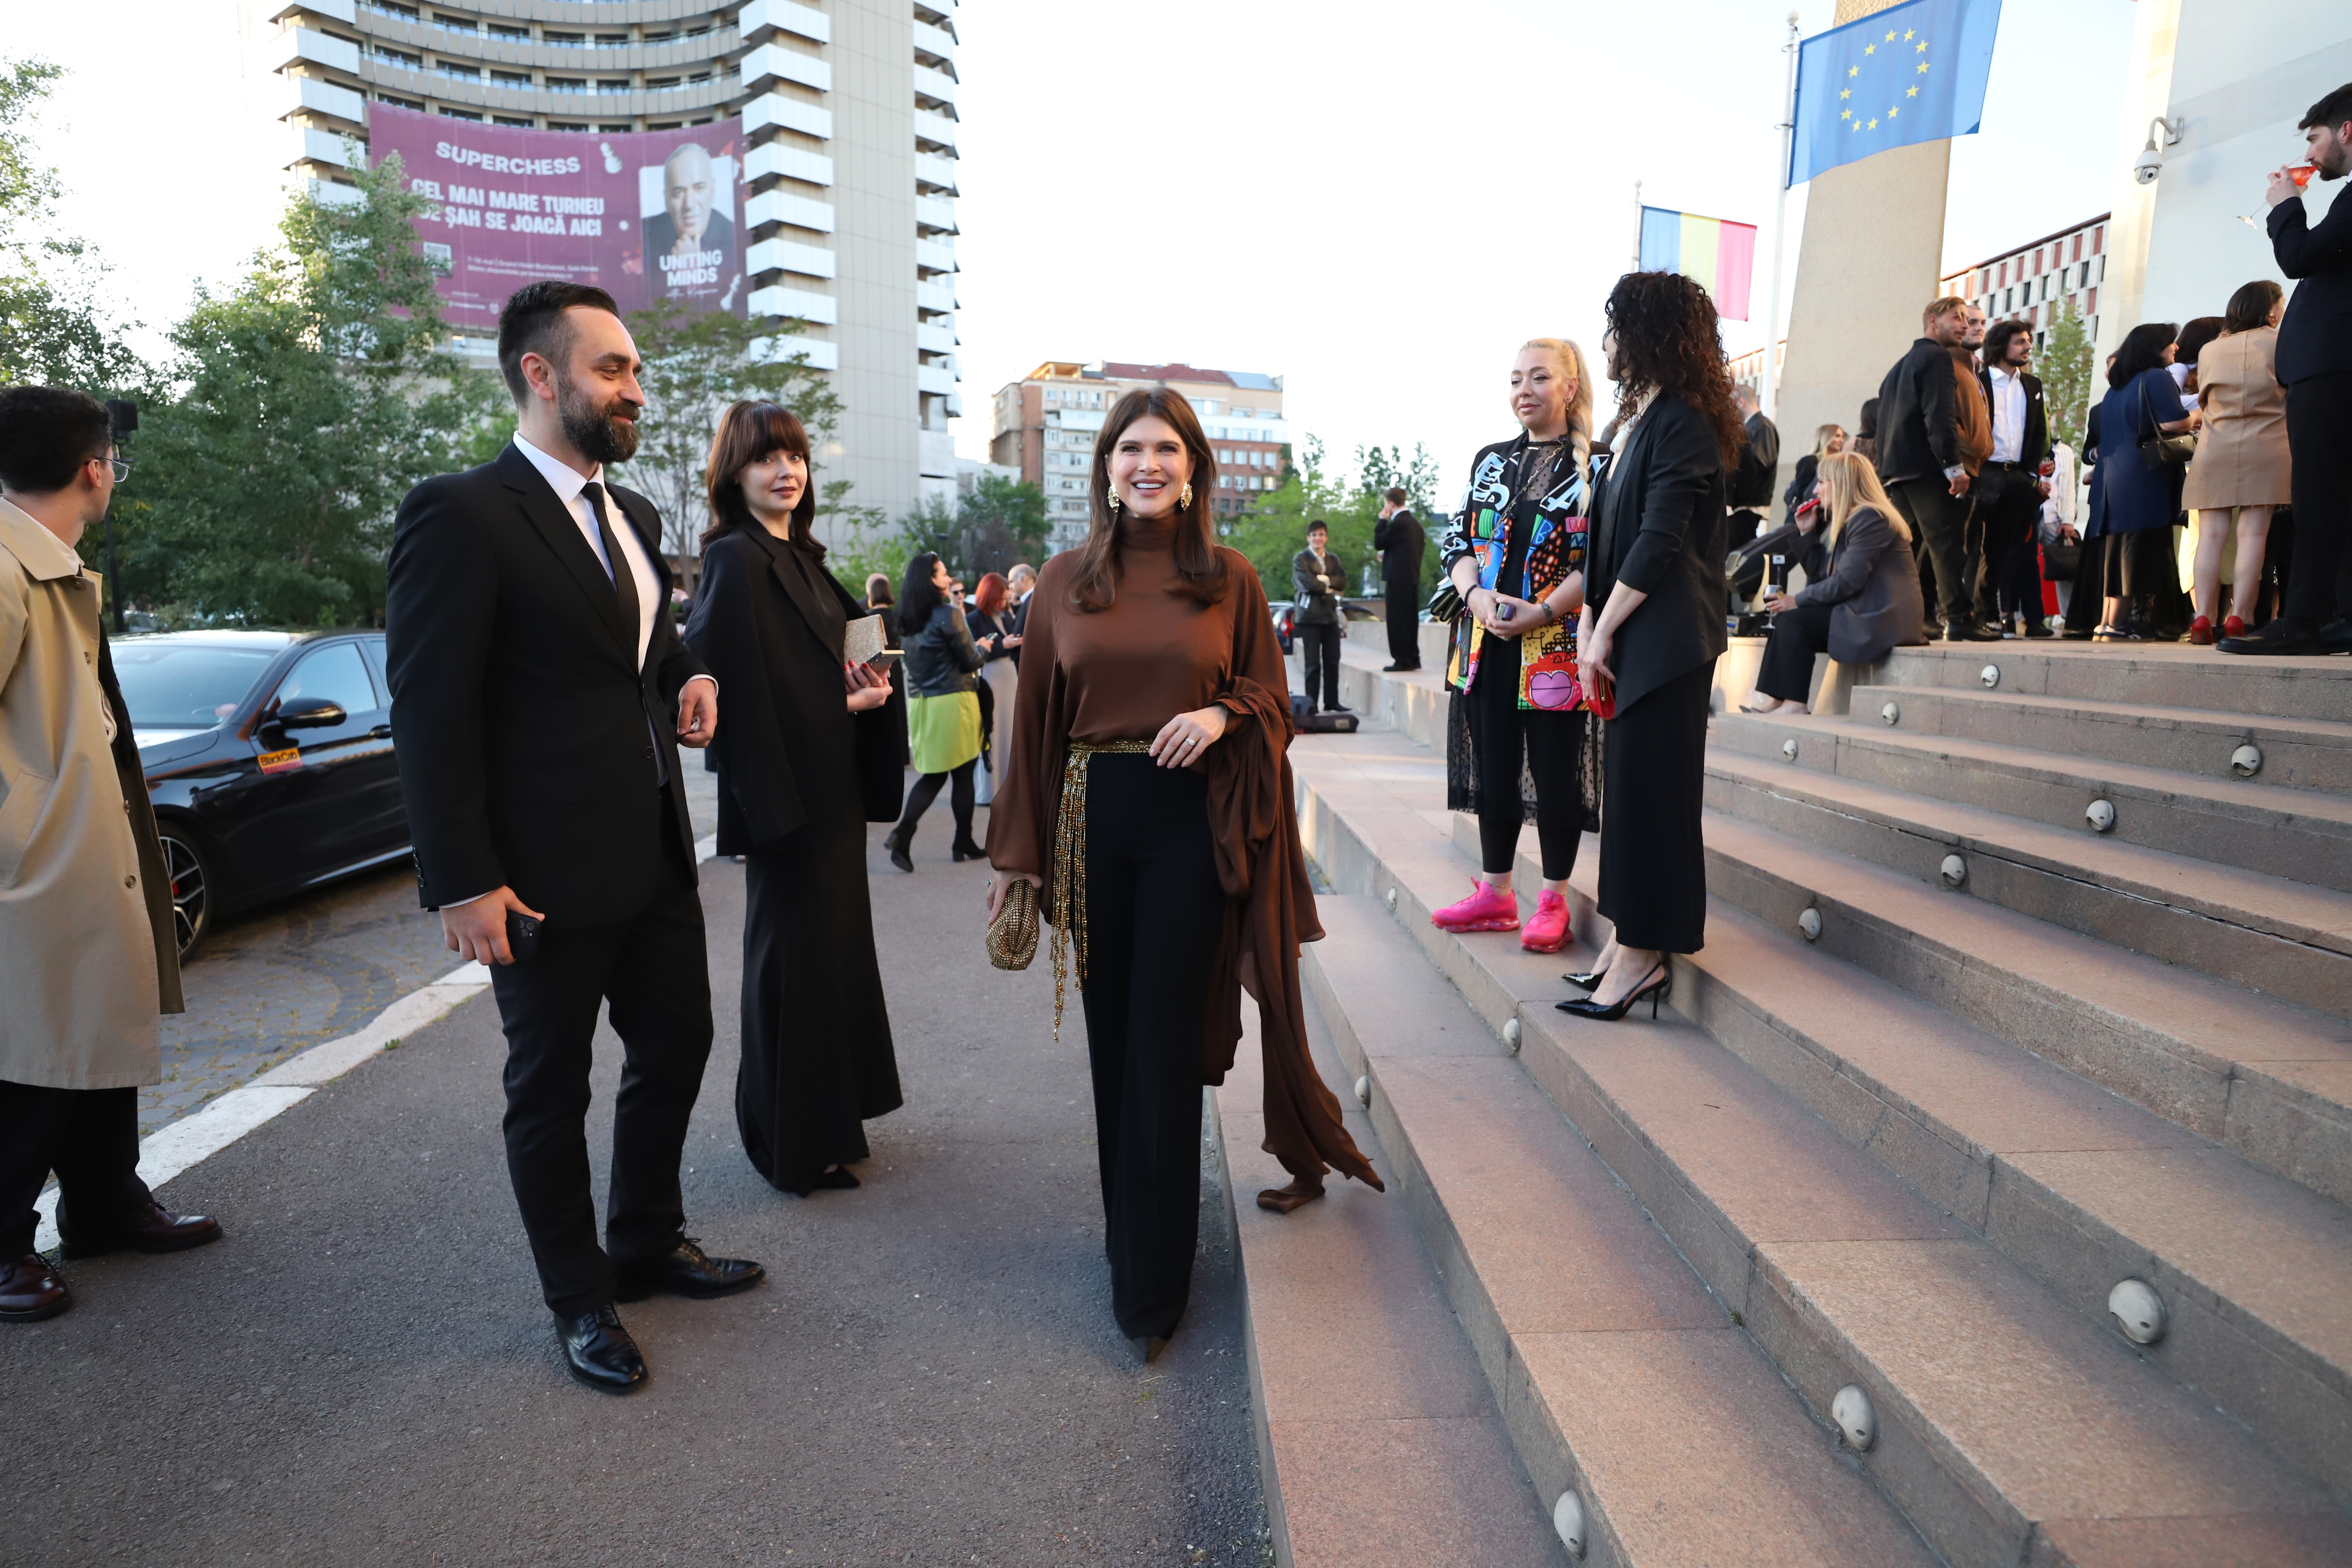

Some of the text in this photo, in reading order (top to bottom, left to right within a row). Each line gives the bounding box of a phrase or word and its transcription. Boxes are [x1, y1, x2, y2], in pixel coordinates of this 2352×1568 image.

[436, 141, 581, 175] SUPERCHESS
[411, 178, 605, 216] CEL MAI MARE TURNEU
[485, 211, 507, 231] SE
[510, 213, 567, 236] JOACĂ
[570, 217, 602, 237] AICI
[659, 249, 723, 271] UNITING
[667, 266, 718, 287] MINDS
